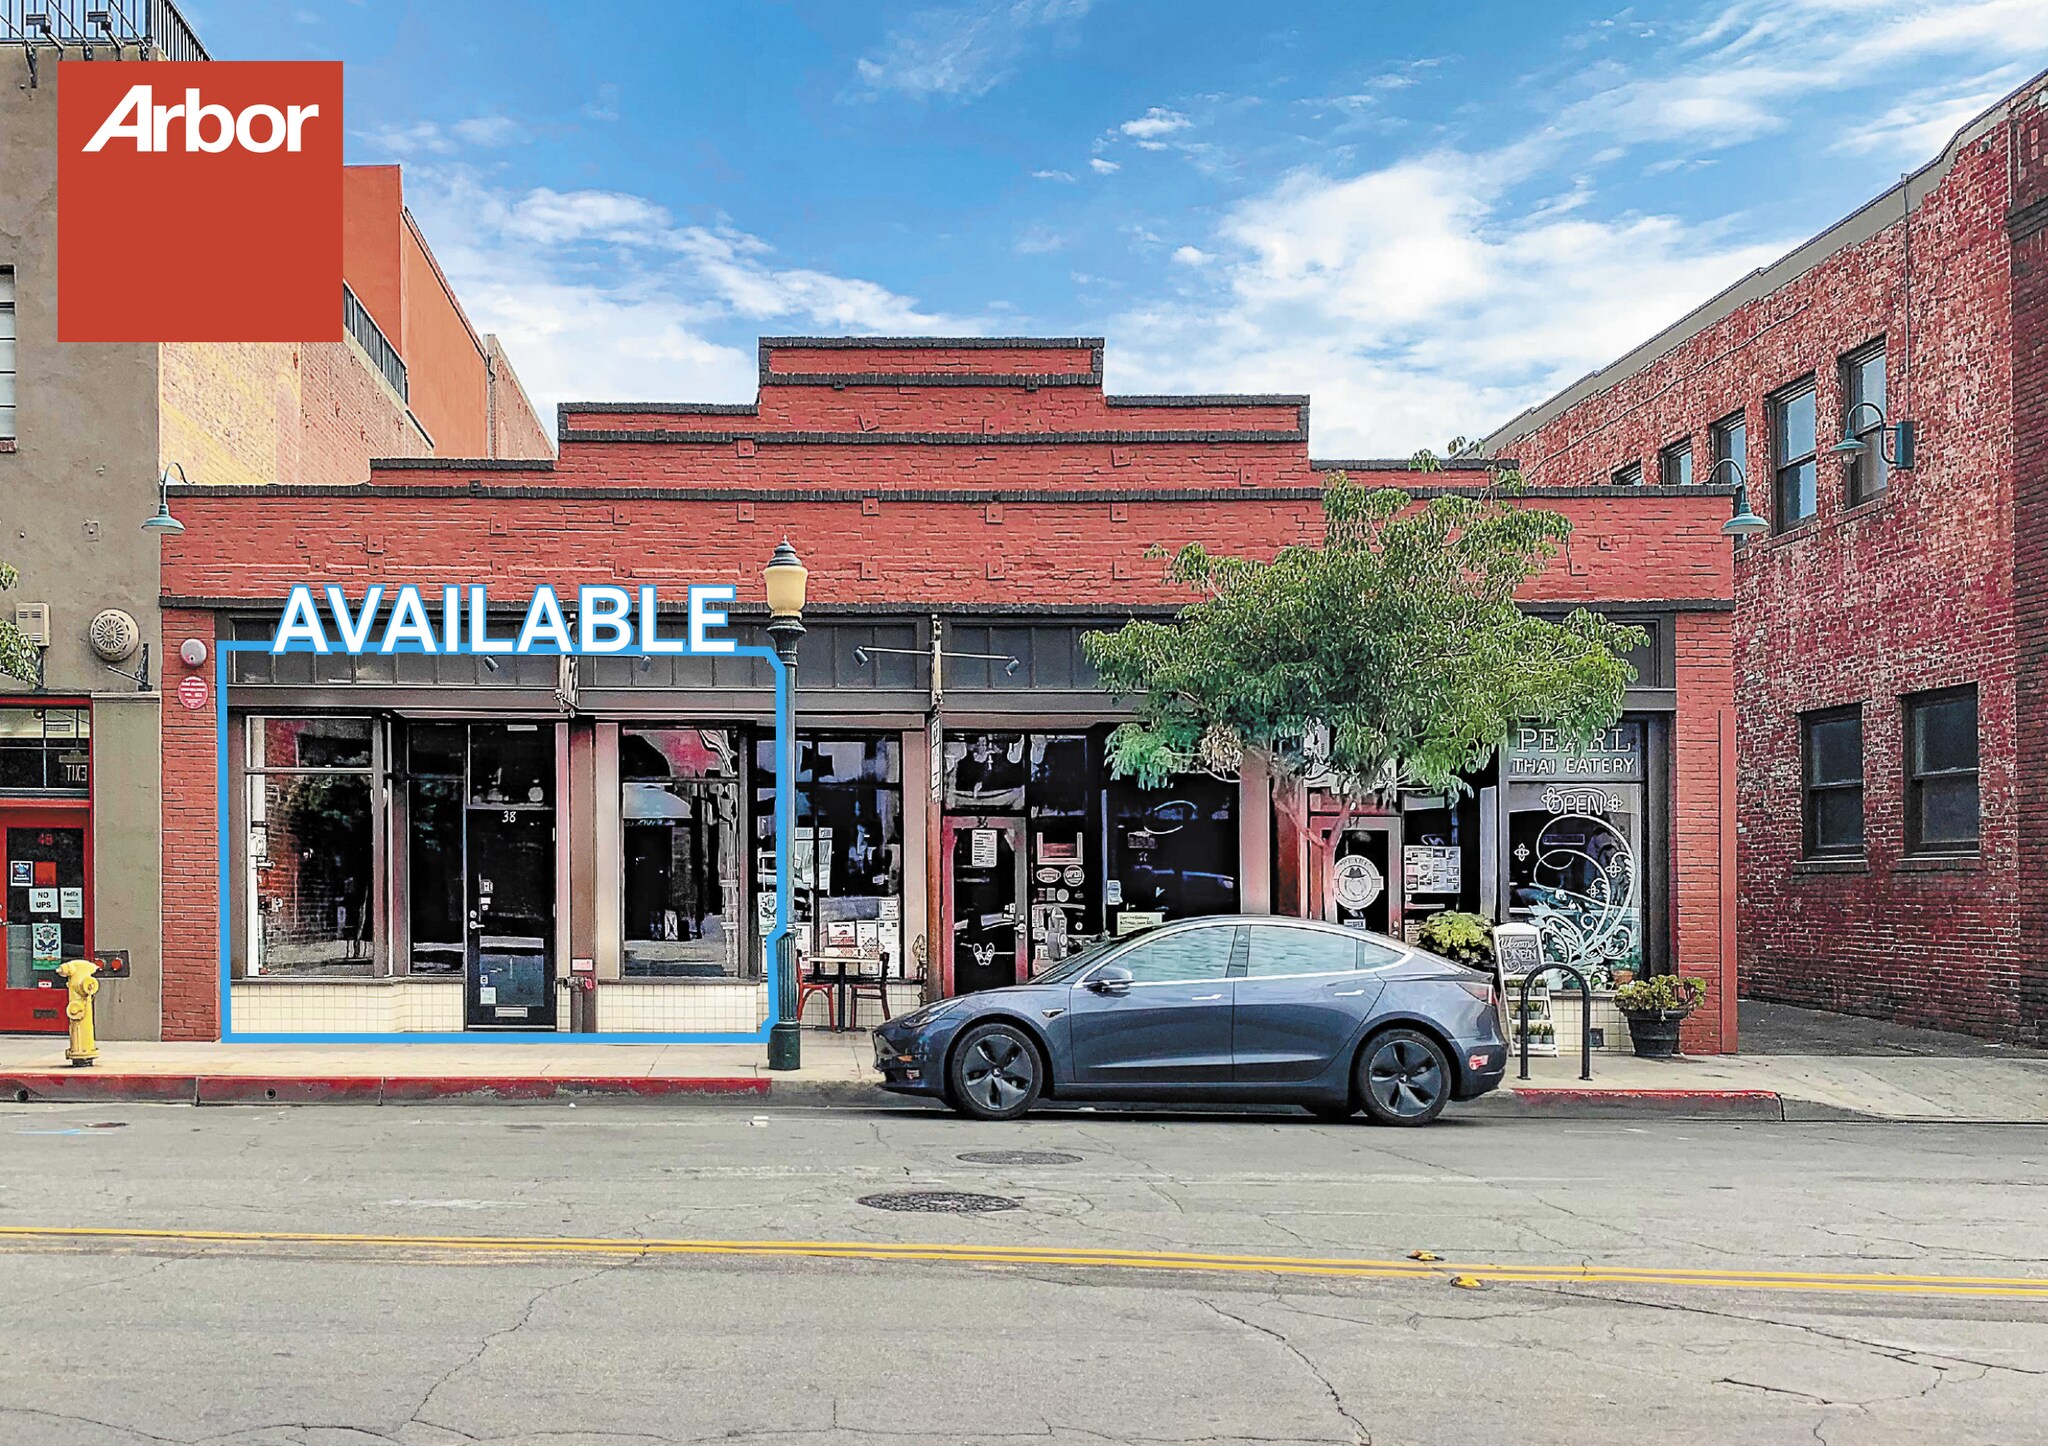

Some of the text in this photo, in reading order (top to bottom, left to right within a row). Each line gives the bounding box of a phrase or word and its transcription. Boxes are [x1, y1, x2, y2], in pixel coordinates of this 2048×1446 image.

[1512, 757, 1635, 774] THAI EATERY
[1546, 794, 1604, 816] OPEN
[501, 810, 517, 824] 38
[37, 891, 49, 899] NO
[35, 901, 52, 909] UPS
